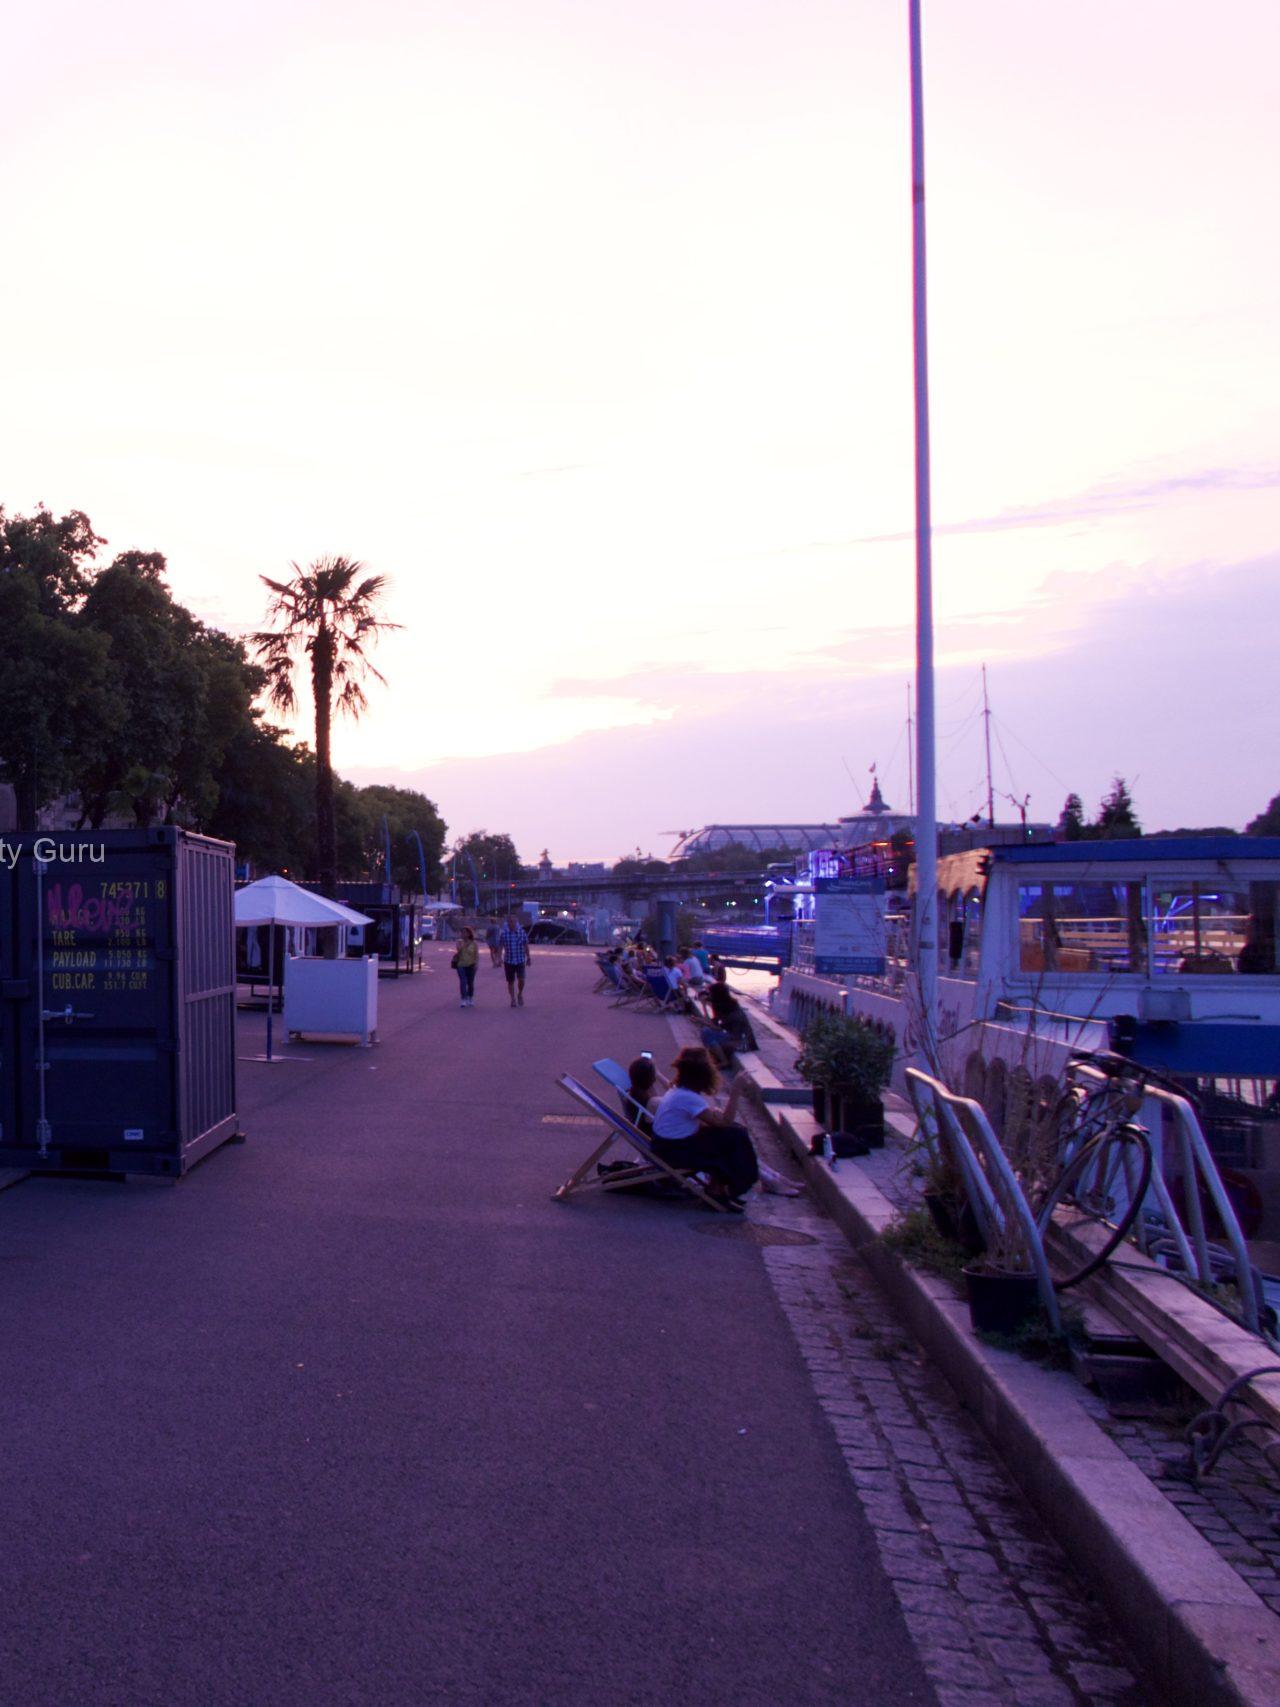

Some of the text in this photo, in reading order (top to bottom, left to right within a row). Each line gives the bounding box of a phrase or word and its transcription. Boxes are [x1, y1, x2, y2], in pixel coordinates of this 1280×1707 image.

[157, 880, 165, 899] 8
[52, 930, 76, 946] TARE
[52, 951, 97, 968] PAYLOAD
[52, 972, 96, 990] CUB.CAP.
